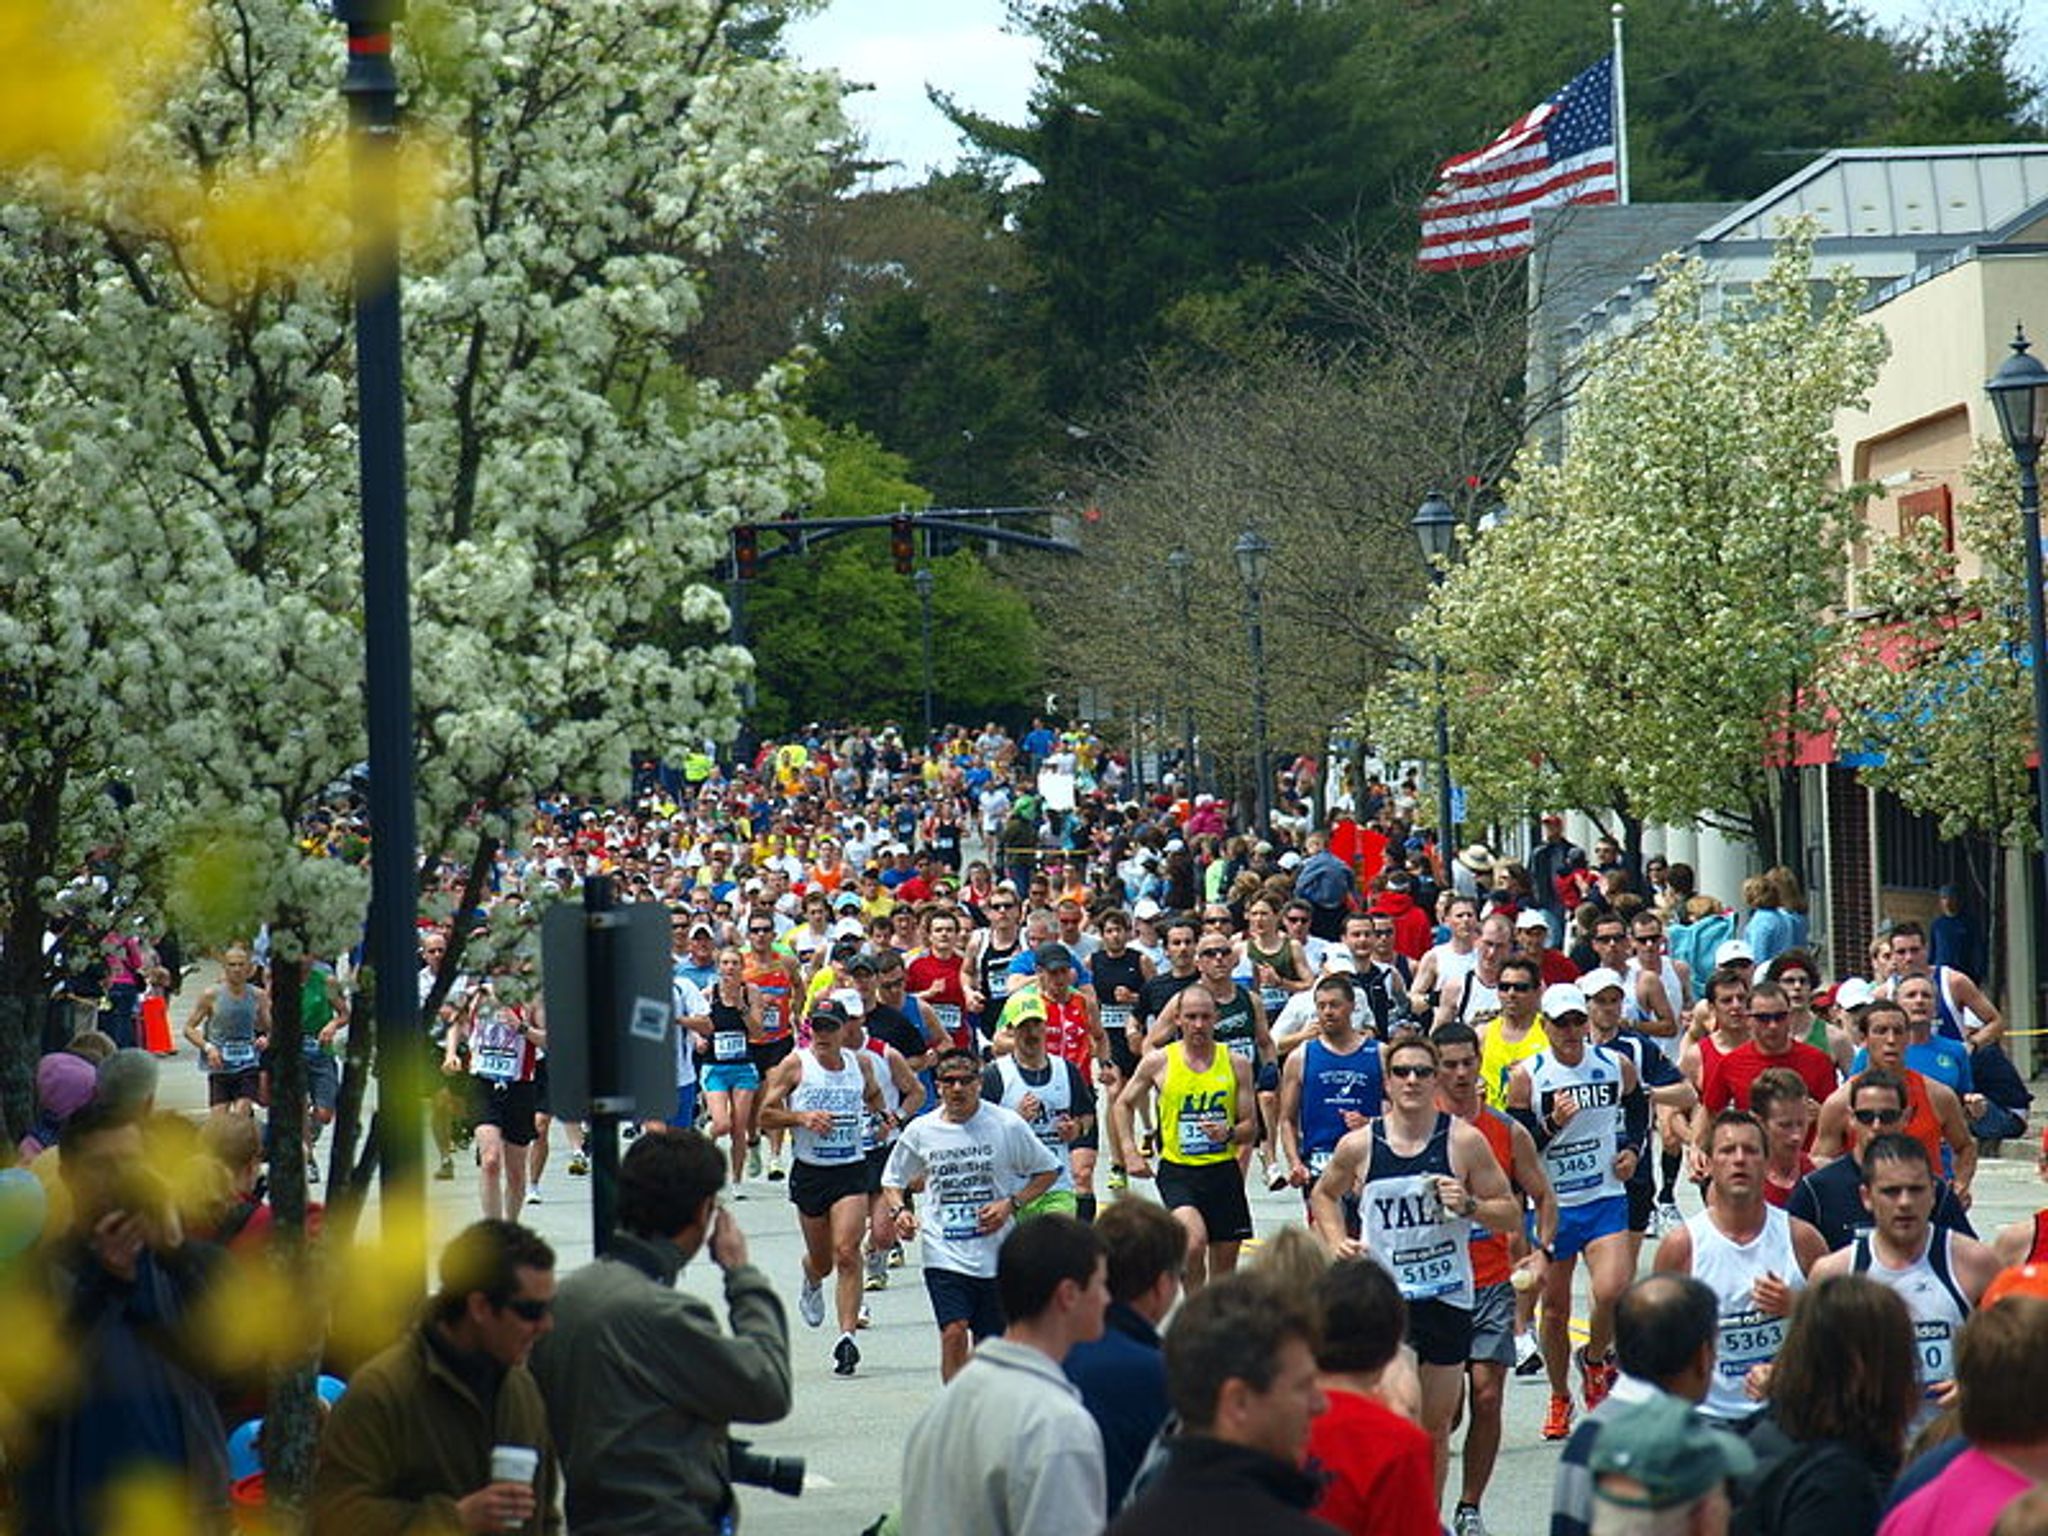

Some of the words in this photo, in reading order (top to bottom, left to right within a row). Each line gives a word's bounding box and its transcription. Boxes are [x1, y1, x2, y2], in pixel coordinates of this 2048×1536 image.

[1555, 1154, 1597, 1176] 3463
[1374, 1195, 1443, 1230] YAL
[1402, 1259, 1452, 1284] 5159
[1724, 1325, 1784, 1350] 5363
[1925, 1345, 1942, 1369] 0
